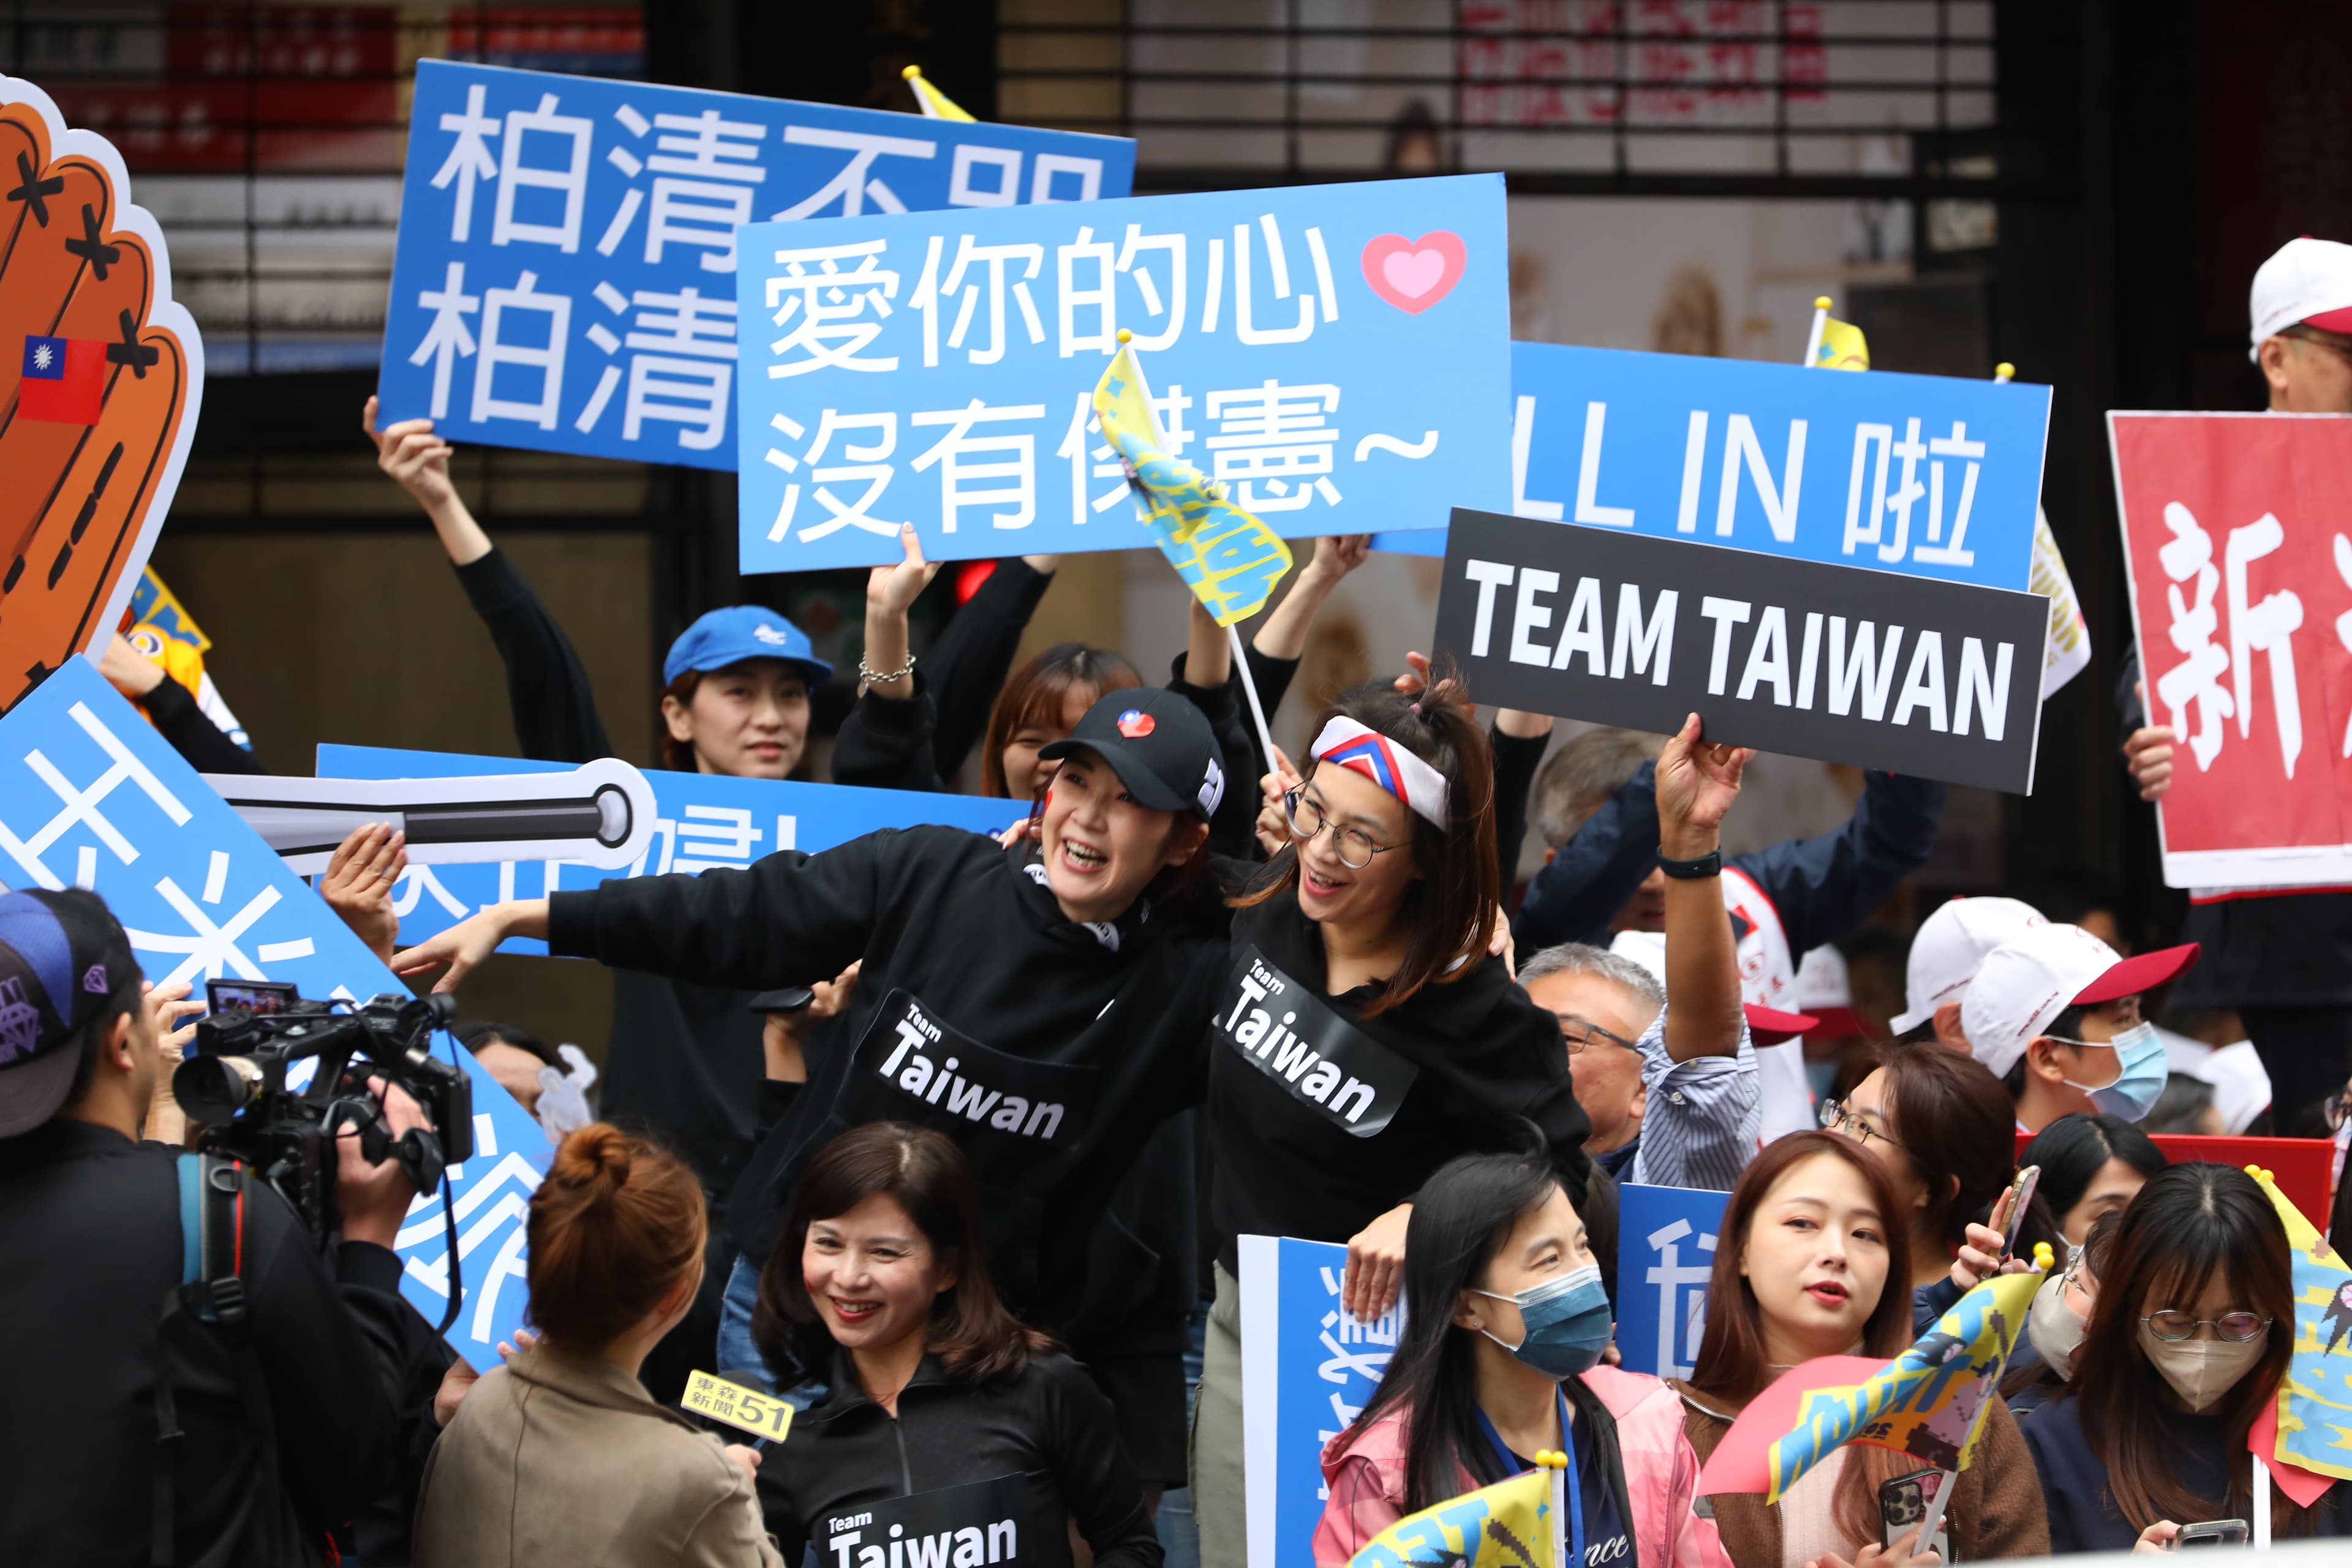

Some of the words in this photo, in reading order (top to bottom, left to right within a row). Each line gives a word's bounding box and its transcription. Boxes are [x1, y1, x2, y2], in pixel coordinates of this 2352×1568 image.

[766, 213, 1339, 380] 愛你的心
[1677, 409, 1808, 543] IN
[1842, 417, 1986, 567] 啦
[1465, 559, 1679, 687] TEAM
[1701, 595, 2014, 741] TAIWAN
[2157, 501, 2352, 781] 新
[1250, 958, 1285, 995] Team
[0, 701, 545, 1344] 玉米派
[900, 1003, 935, 1042] Team
[1225, 974, 1376, 1123] Taiwan
[878, 1019, 1064, 1139] Taiwan
[690, 1391, 734, 1417] 新聞
[695, 1378, 737, 1402] 東森
[737, 1395, 786, 1433] 51
[829, 1512, 872, 1534] Team
[829, 1519, 1017, 1568] Taiwan
[1585, 1534, 1629, 1567] nce
